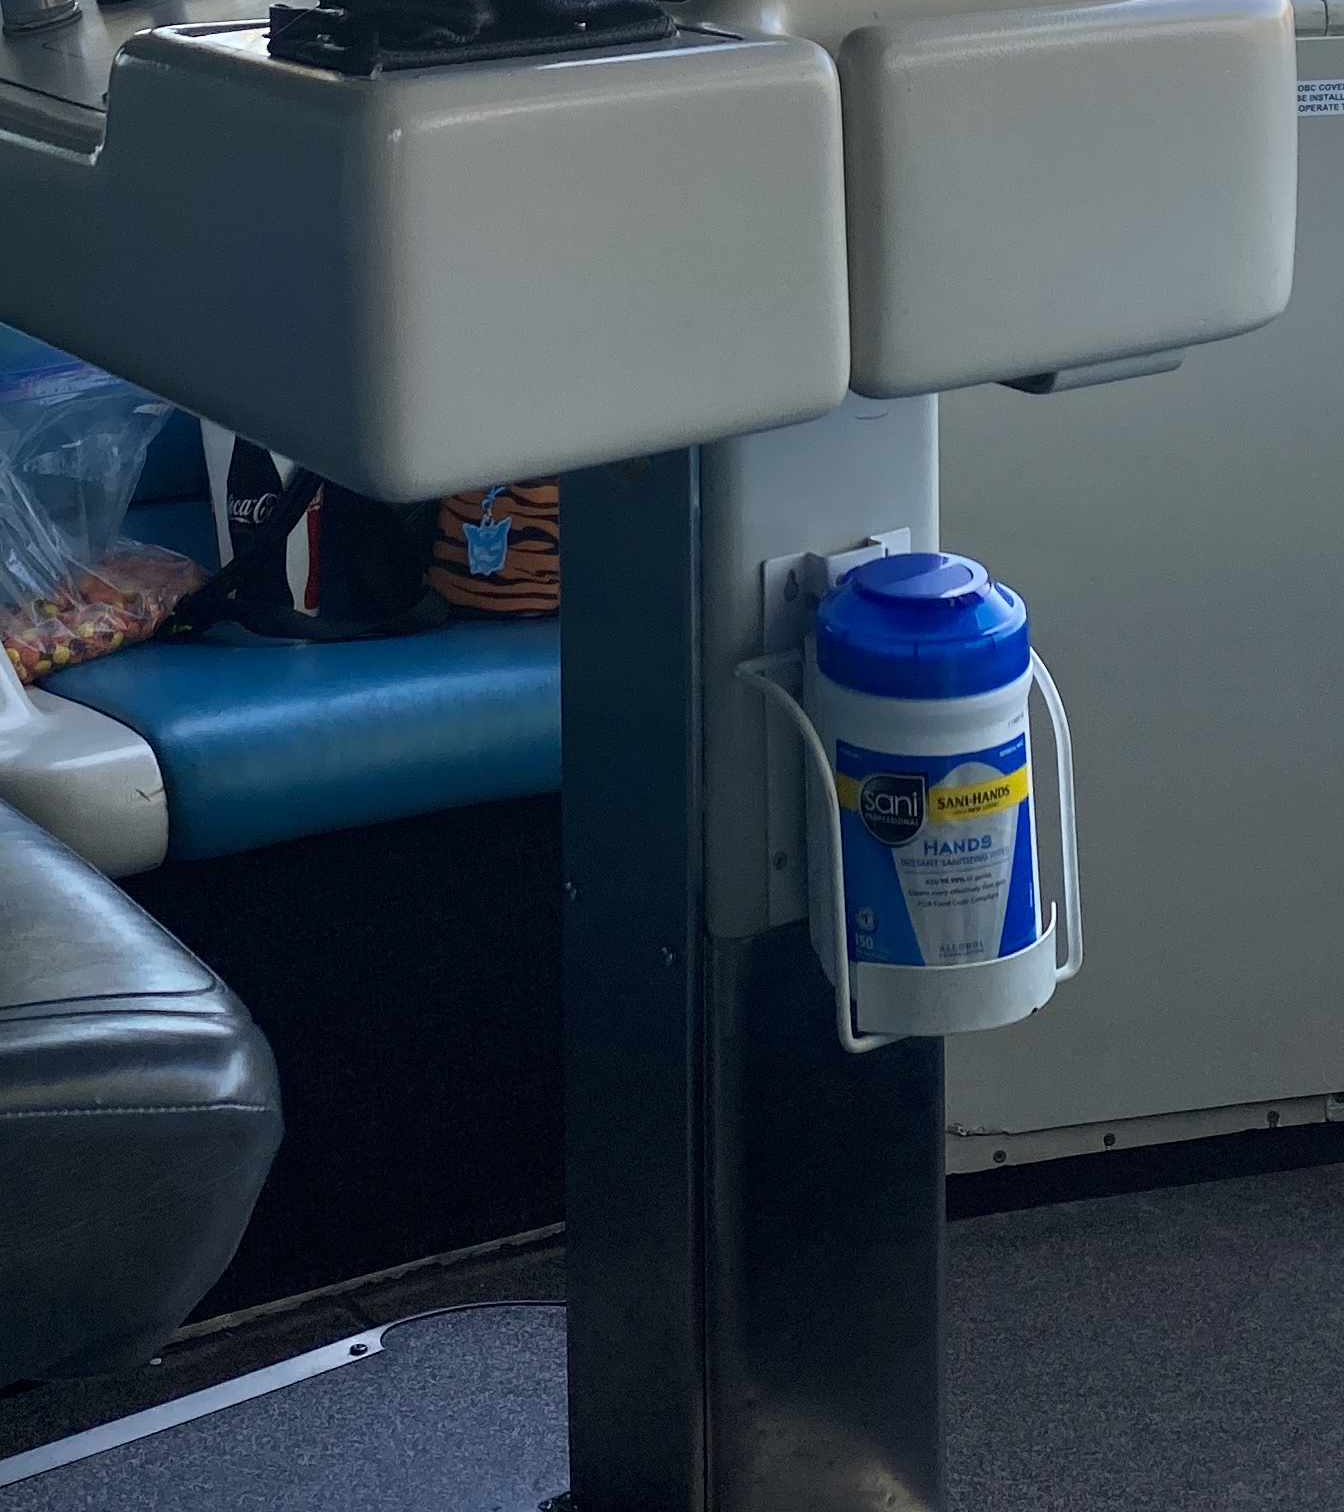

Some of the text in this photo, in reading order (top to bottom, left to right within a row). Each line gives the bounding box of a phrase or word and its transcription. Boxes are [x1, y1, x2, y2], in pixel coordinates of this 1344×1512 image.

[1297, 94, 1307, 102] BE
[1298, 103, 1339, 112] OPERATE
[923, 834, 993, 856] HANDS
